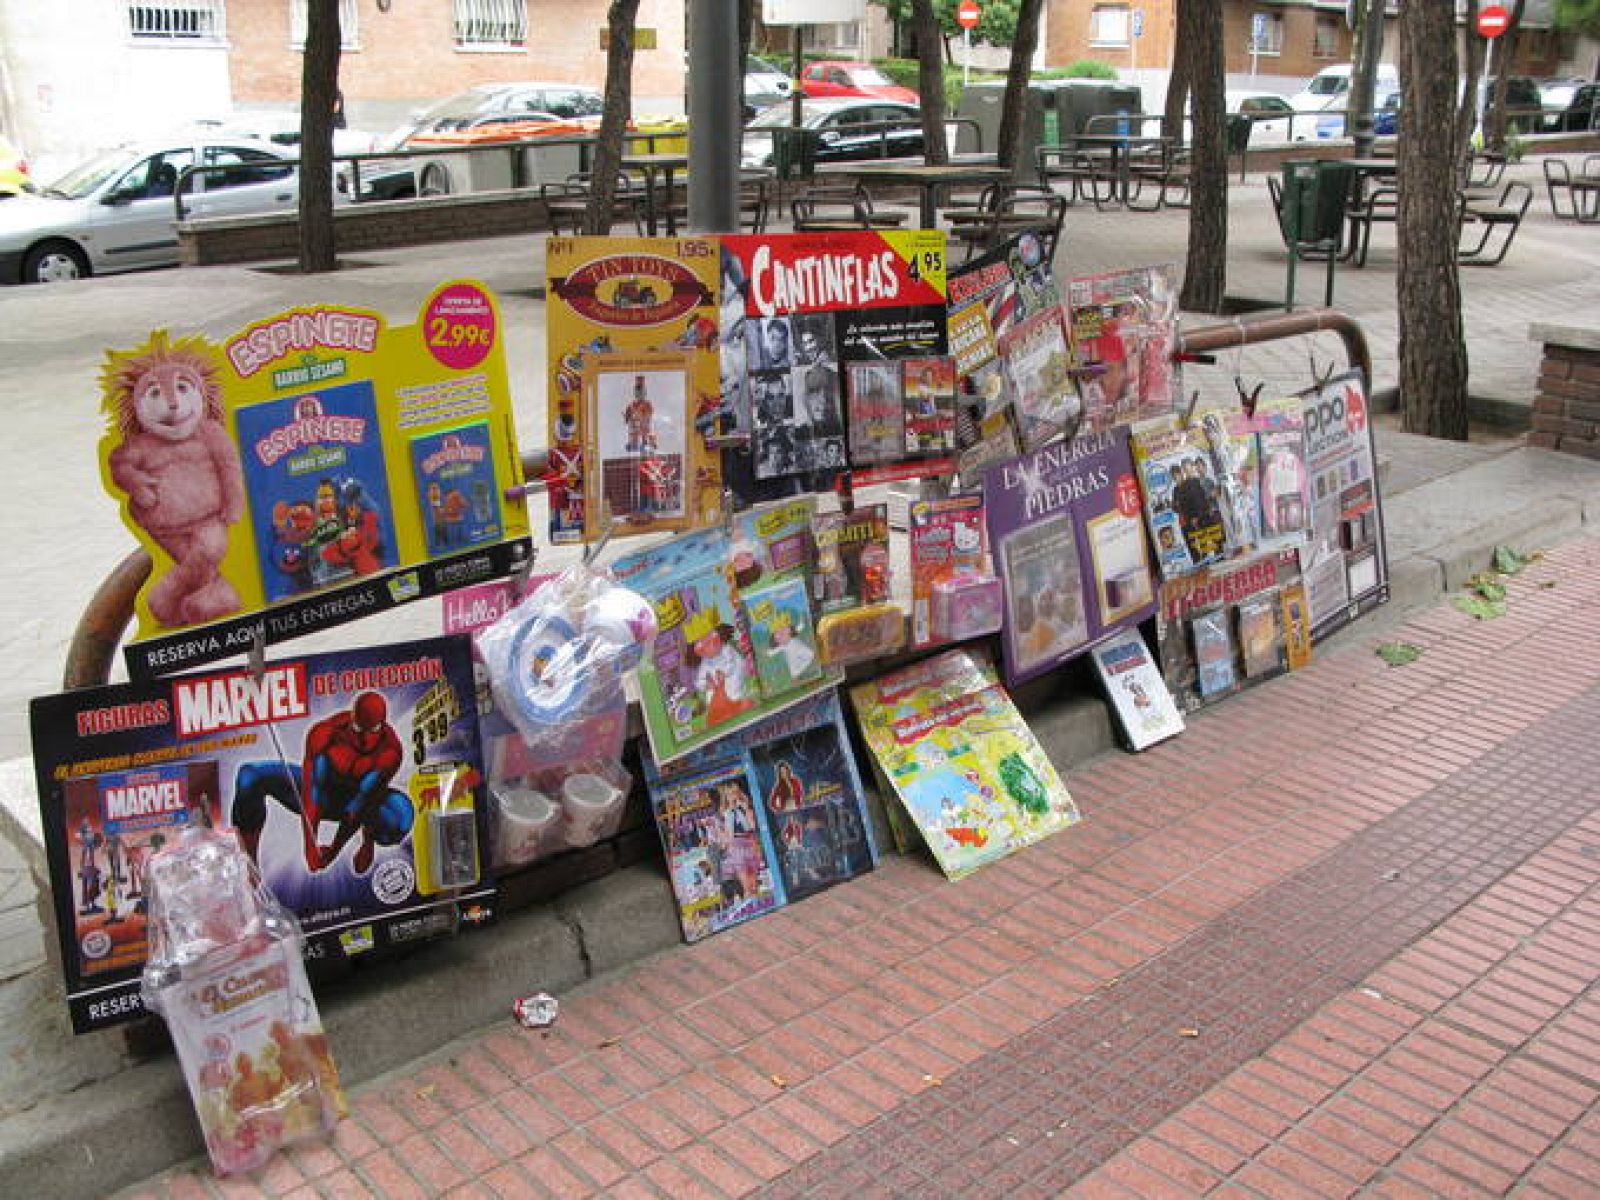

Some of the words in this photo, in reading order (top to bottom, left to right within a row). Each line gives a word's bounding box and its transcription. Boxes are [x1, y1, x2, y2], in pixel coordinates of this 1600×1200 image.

[752, 244, 898, 316] CANTINFLAS
[227, 312, 378, 376] ESPINETE
[256, 416, 365, 466] ESPINETE
[1304, 396, 1344, 442] ppo
[1024, 466, 1110, 520] PIEDRAS
[147, 640, 220, 667] RESERVA
[269, 612, 298, 633] TUS
[303, 590, 375, 625] ENTREGAS
[77, 698, 170, 737] FIGURAS
[178, 667, 305, 735] MARVEL
[312, 673, 337, 697] DE
[106, 780, 184, 819] MARVEL
[89, 993, 142, 1020] RESER
